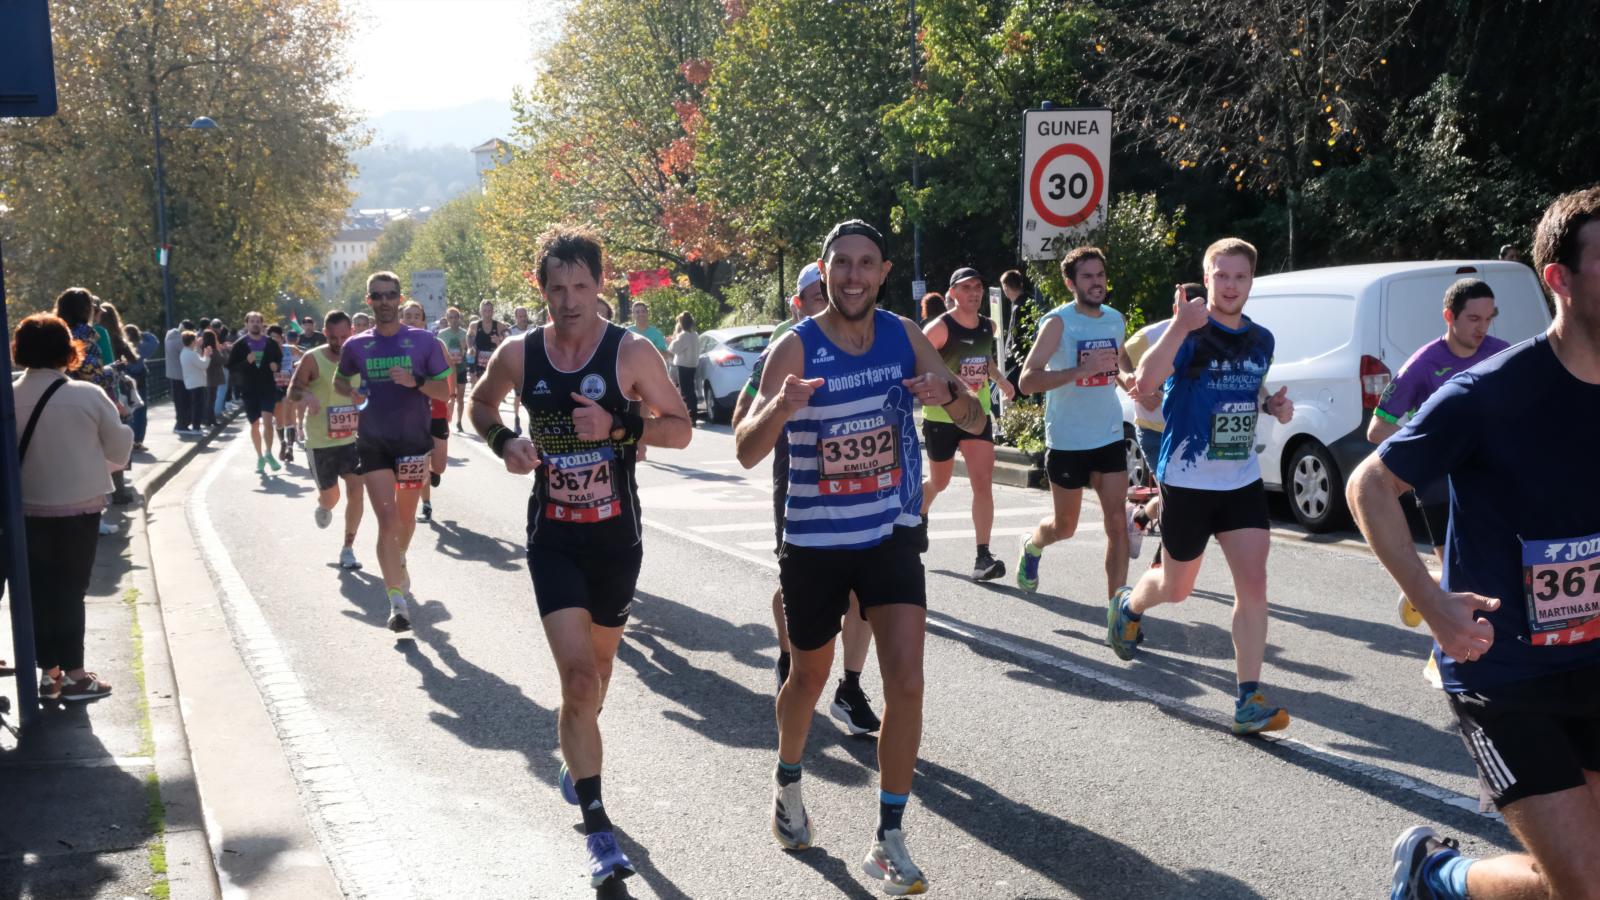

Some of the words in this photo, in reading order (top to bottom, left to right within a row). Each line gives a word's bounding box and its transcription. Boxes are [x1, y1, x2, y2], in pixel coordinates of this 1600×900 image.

[1037, 120, 1100, 136] GUNEA
[1048, 172, 1088, 200] 30
[824, 430, 892, 463] 3392
[844, 460, 878, 471] EMILIO
[550, 464, 609, 490] 3674
[567, 493, 595, 502] TXABI
[1539, 602, 1600, 619] MARTINA&M
